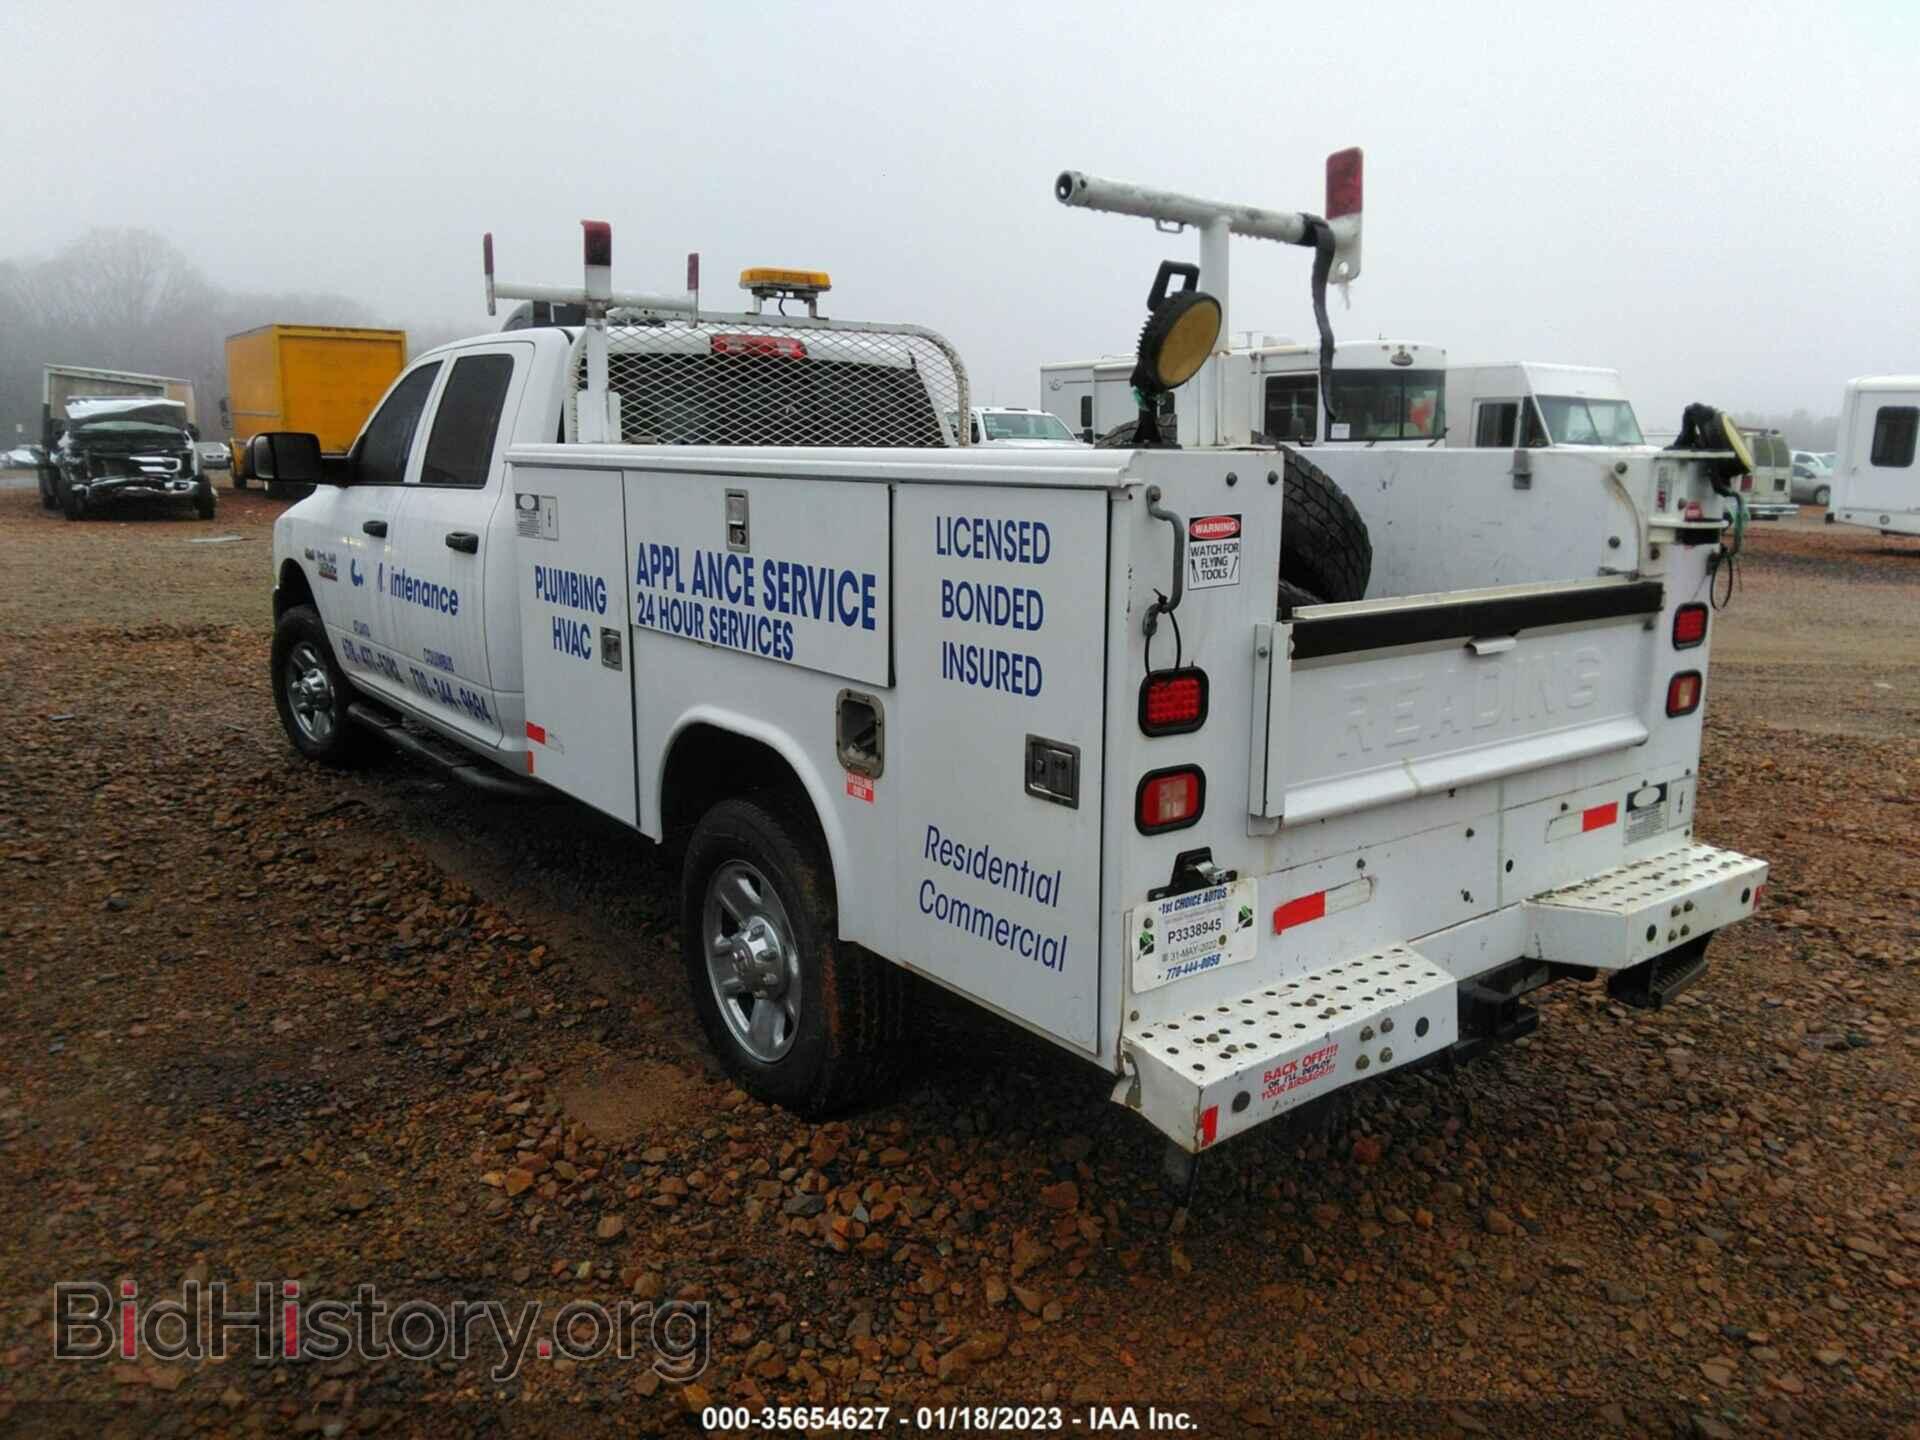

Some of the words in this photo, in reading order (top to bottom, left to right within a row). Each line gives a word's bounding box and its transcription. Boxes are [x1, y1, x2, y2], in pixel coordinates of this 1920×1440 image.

[936, 516, 1050, 564] LICENSED
[1195, 522, 1236, 534] WARNING
[1191, 544, 1222, 557] WATCH
[1223, 543, 1239, 553] FOR
[1201, 556, 1228, 568] FLYING
[534, 565, 607, 615] PLUMBING
[1201, 568, 1228, 580] TOOLS
[763, 559, 876, 631] SERVICE
[941, 579, 1044, 632] BONDED
[552, 616, 592, 660] HVAC
[637, 591, 655, 626] 24
[659, 597, 705, 639] HOUR
[709, 606, 794, 661] SERVICES
[942, 641, 1043, 697] INSURED
[924, 825, 1062, 908] Residential
[1174, 893, 1202, 911] CHOICE
[1203, 886, 1227, 903] AUTOS
[919, 879, 1068, 972] Commercial
[1168, 918, 1222, 944] P3338945
[1264, 1060, 1298, 1084] BACK
[1268, 1079, 1280, 1089] OR
[1262, 1086, 1286, 1102] YOUR
